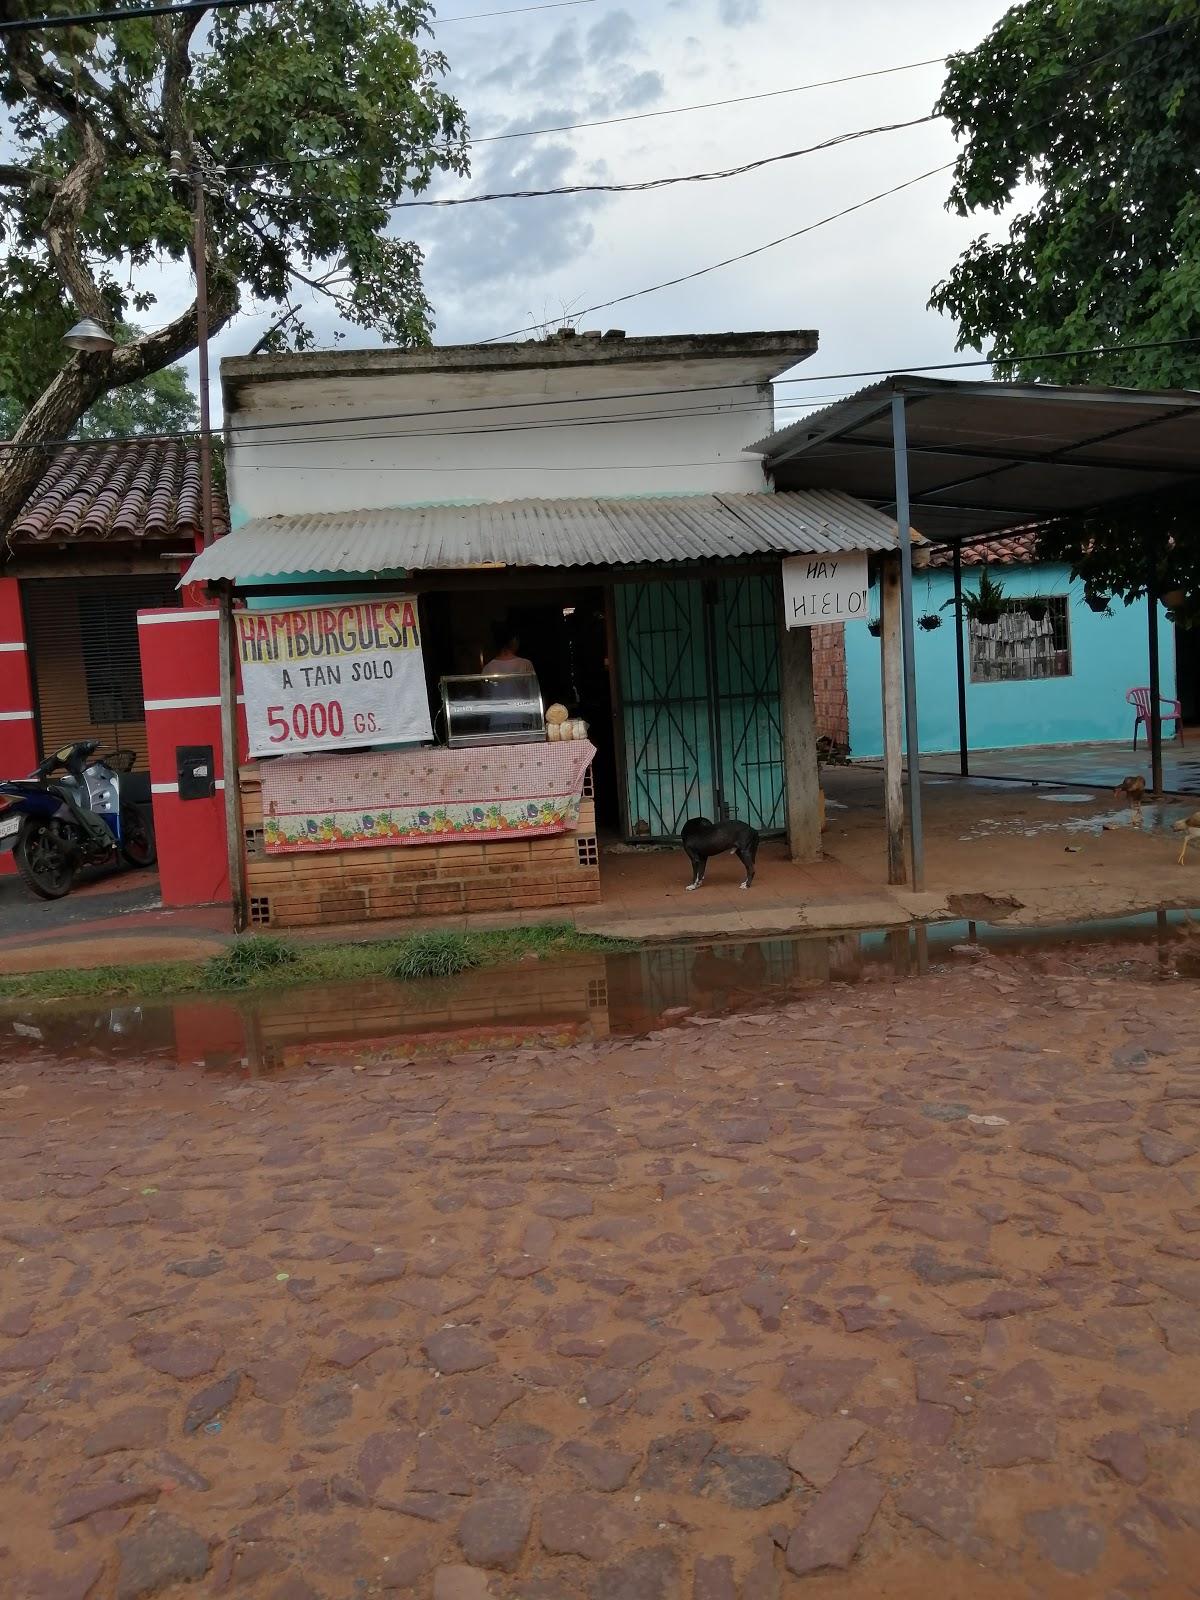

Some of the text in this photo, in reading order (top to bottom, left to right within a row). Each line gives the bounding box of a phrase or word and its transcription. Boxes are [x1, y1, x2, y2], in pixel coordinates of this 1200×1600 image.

[806, 562, 838, 579] HAY
[238, 602, 420, 662] HAMBURGUESA
[282, 660, 393, 689] A TAN SOLO
[267, 700, 382, 743] 5.000 GS.
